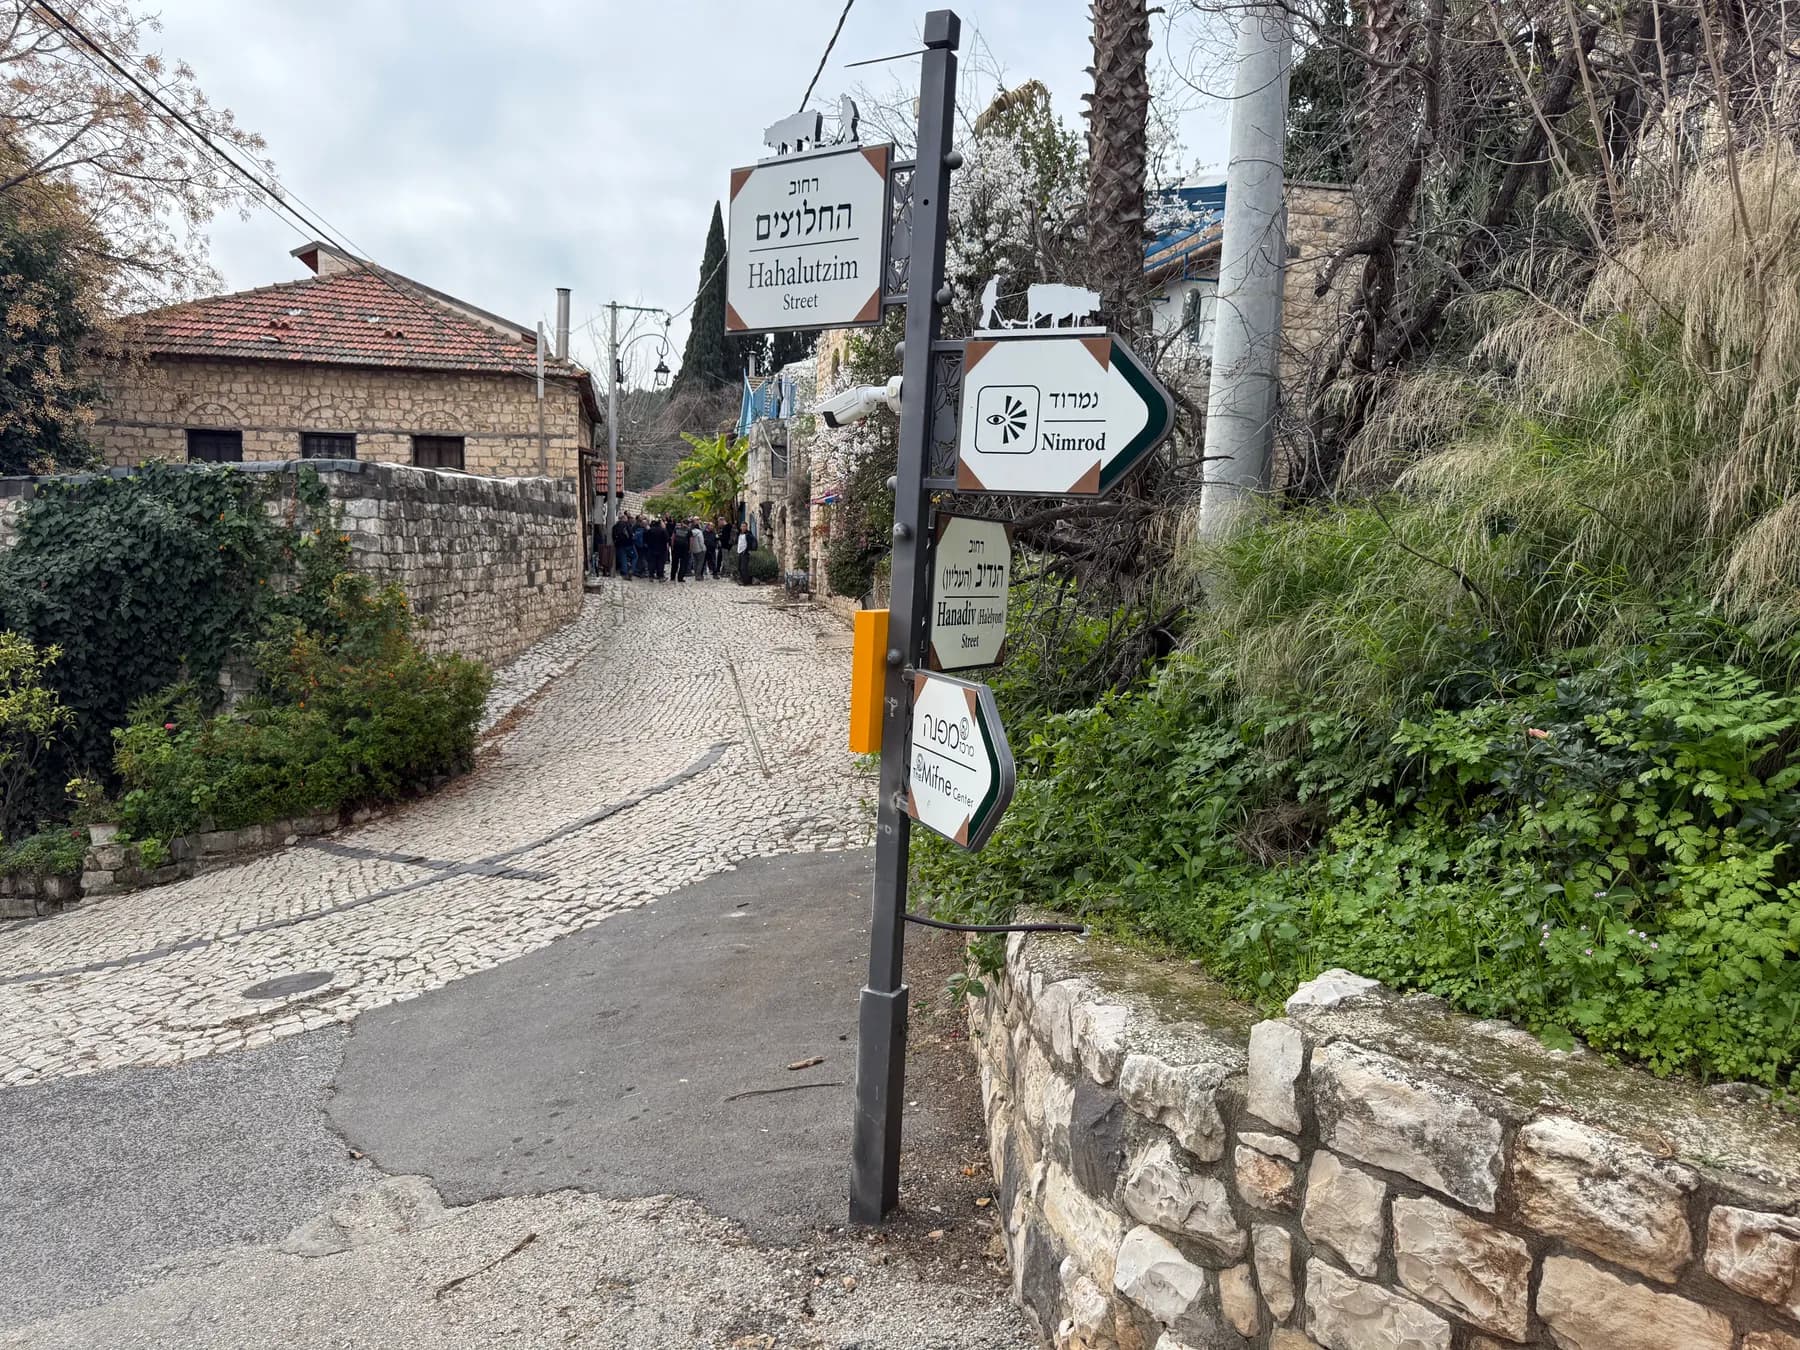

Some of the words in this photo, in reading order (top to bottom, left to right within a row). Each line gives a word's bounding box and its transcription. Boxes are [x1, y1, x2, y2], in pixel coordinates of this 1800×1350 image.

[788, 177, 819, 196] רחוב
[756, 198, 852, 241] החלוצים
[747, 255, 859, 289] Hahalutzim
[783, 293, 819, 311] Street
[1049, 391, 1099, 409] נמרוד
[1041, 432, 1106, 451] Nimrod
[968, 539, 985, 554] רחוב
[975, 561, 1004, 589] הנדיב
[936, 600, 977, 627] Hanadiv
[961, 633, 979, 649] Street
[922, 761, 952, 796] Mifne
[952, 787, 974, 808] Center
